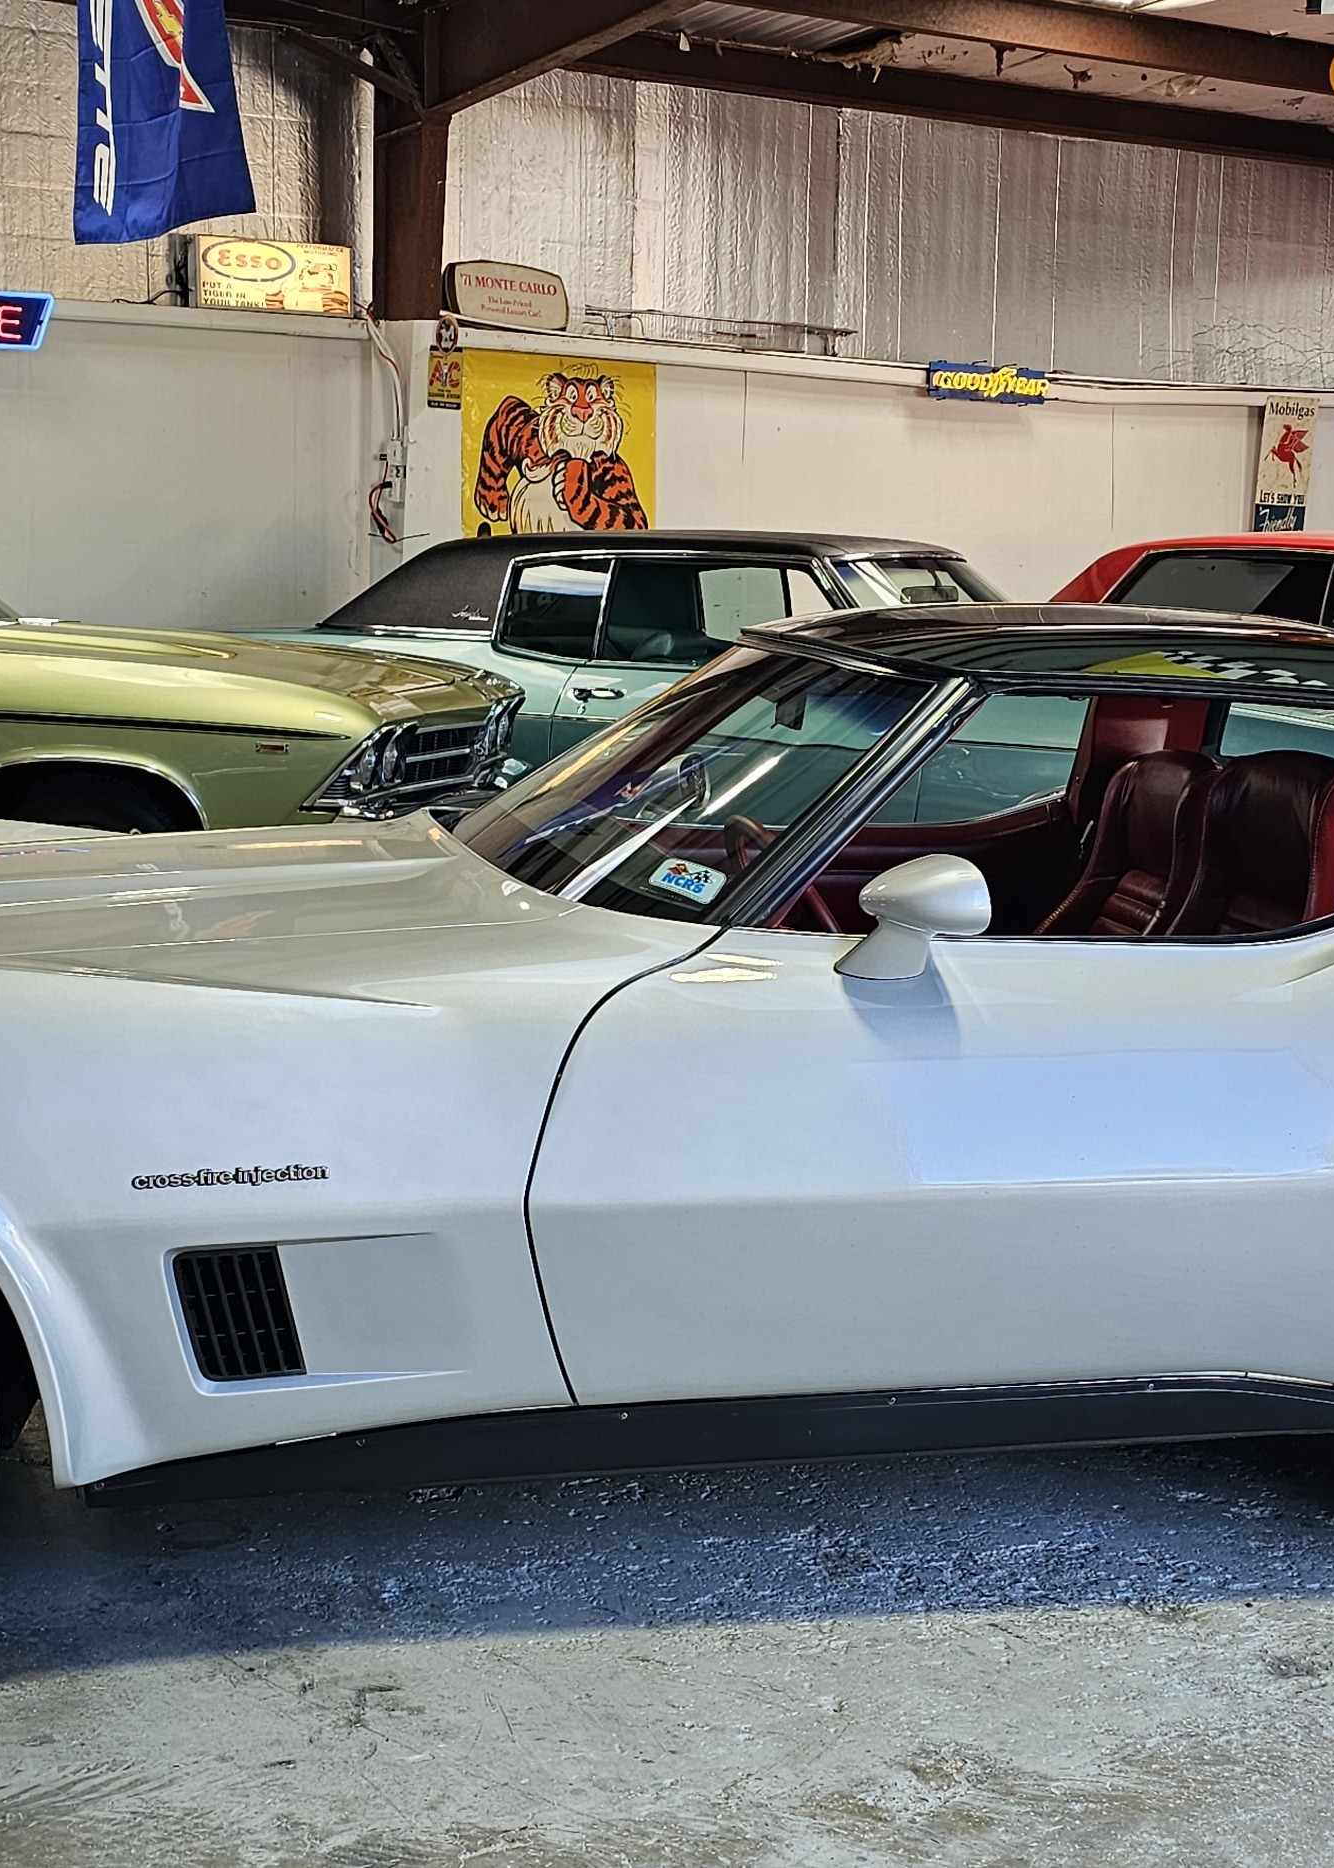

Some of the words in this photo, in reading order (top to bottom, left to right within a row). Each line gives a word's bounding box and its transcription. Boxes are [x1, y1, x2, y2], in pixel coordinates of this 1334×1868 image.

[202, 281, 222, 289] PUT
[475, 276, 517, 292] MONTE
[519, 281, 557, 297] CARLO
[202, 289, 233, 299] TIGER
[202, 298, 231, 307] YOUR
[1269, 402, 1315, 420] Mobilgas
[661, 872, 706, 895] NCRS
